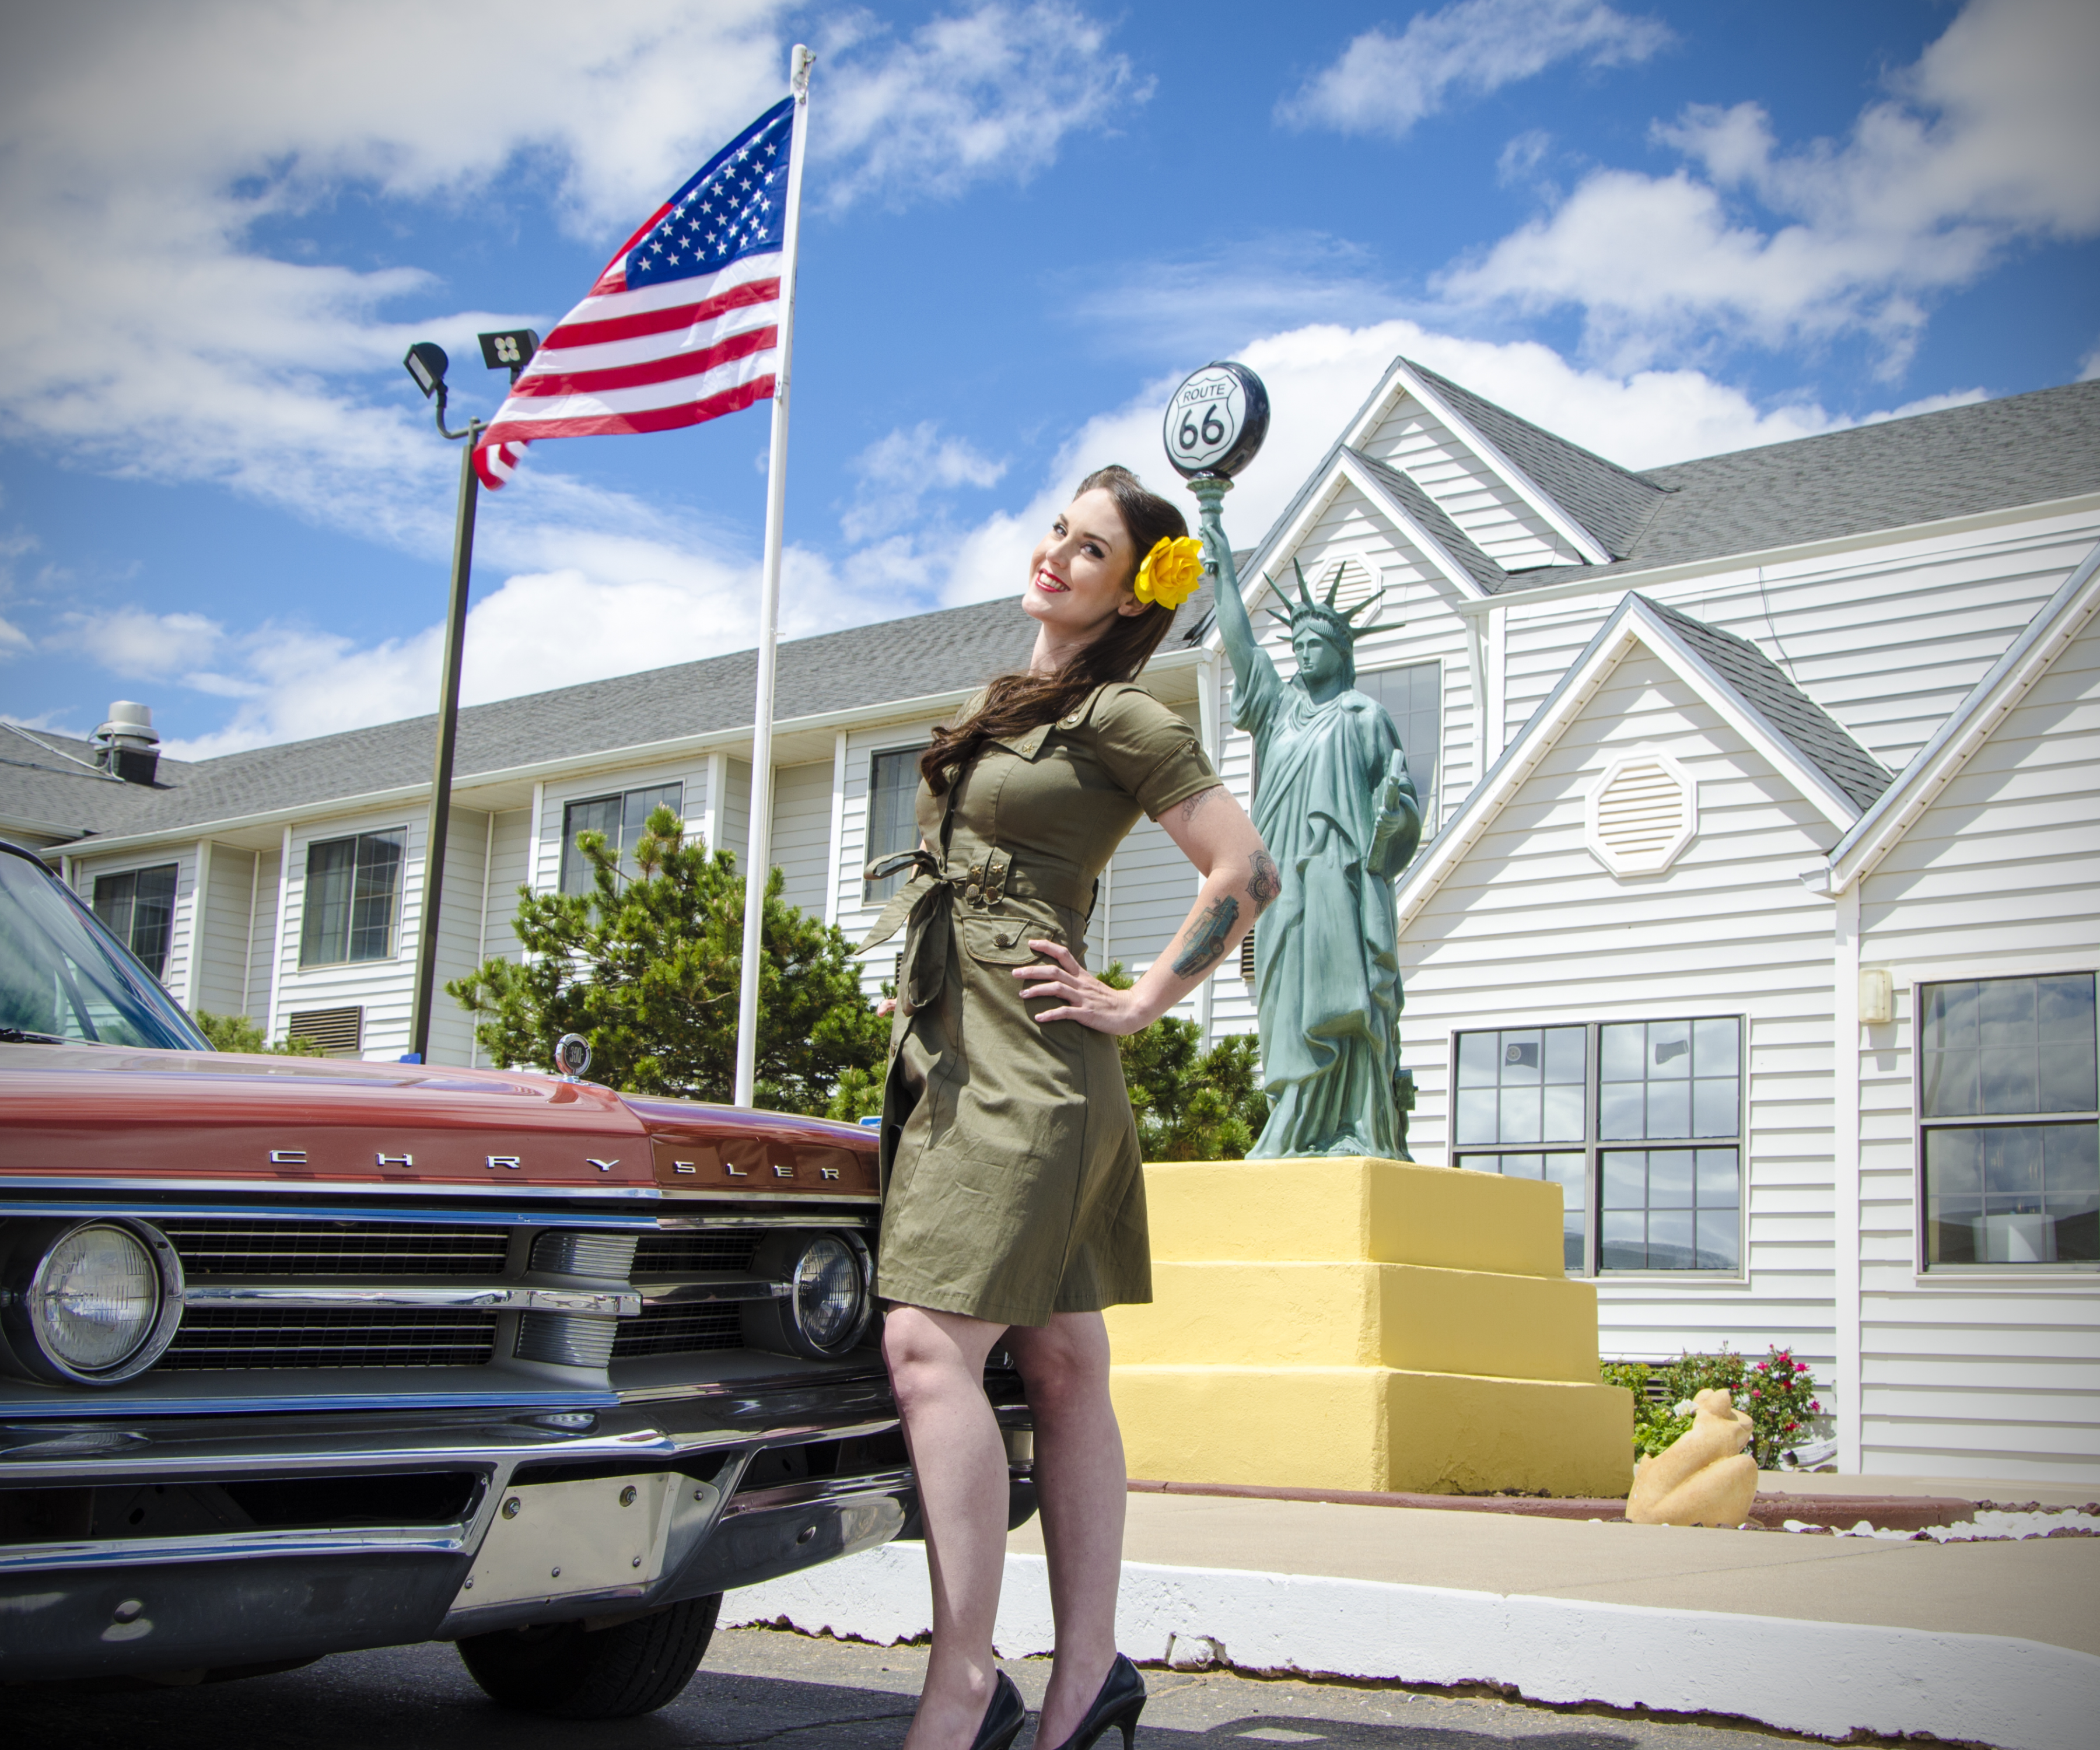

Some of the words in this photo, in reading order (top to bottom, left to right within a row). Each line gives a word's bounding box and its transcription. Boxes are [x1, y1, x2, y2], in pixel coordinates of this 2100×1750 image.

[1182, 383, 1226, 403] ROUTE
[1179, 403, 1225, 450] 66
[270, 1149, 840, 1180] CHRYSLER
